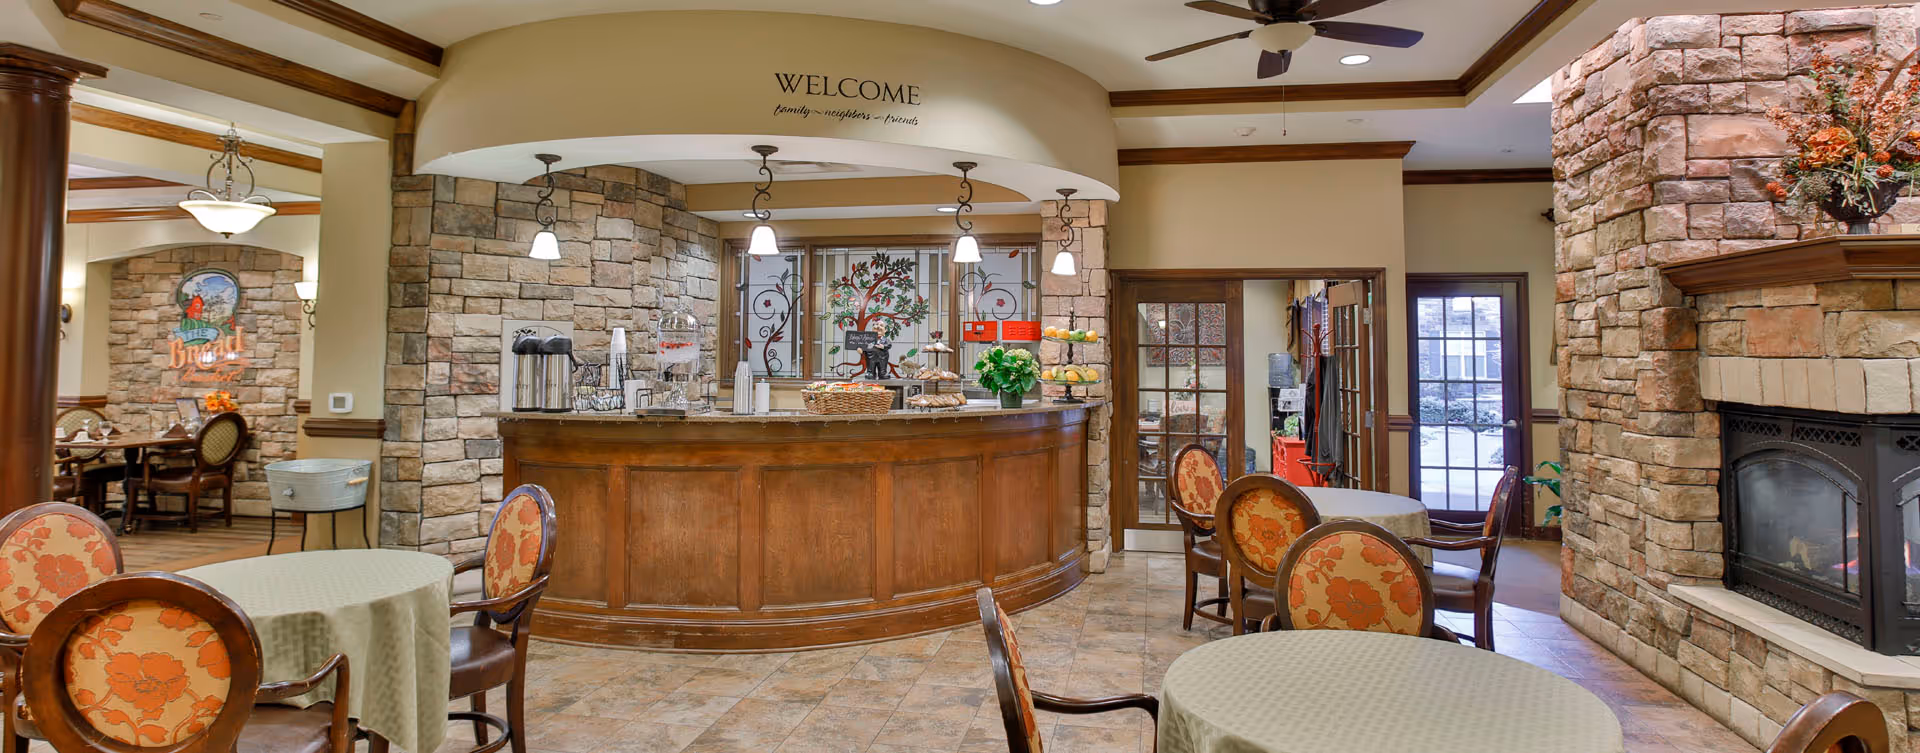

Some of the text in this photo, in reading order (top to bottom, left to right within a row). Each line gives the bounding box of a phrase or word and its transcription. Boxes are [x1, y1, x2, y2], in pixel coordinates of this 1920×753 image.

[774, 72, 921, 106] WELCOME
[773, 103, 919, 127] family neighbors friends
[167, 325, 246, 370] Bread
[184, 328, 208, 341] THE
